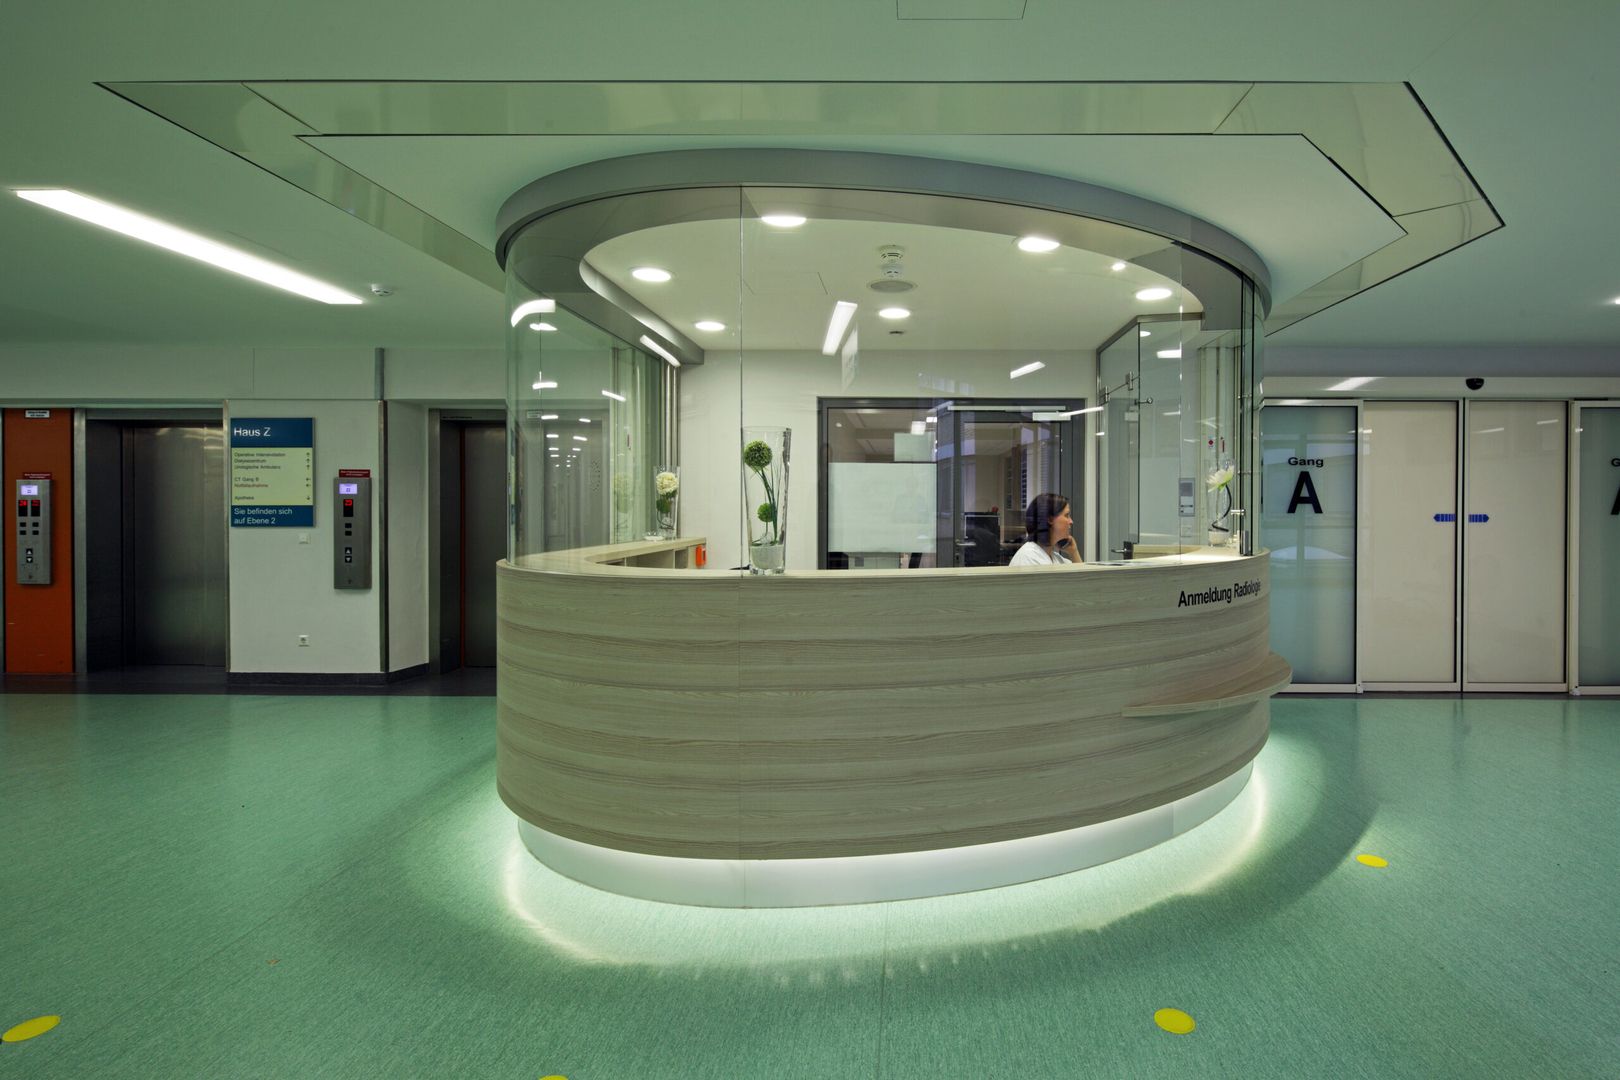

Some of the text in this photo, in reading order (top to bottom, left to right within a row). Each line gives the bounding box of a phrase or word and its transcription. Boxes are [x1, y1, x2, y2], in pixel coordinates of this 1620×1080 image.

[233, 426, 271, 437] Haus Z
[1288, 456, 1324, 468] Gang
[1287, 470, 1324, 514] A
[247, 507, 277, 515] befinden
[278, 507, 293, 515] sich
[233, 517, 276, 525] auf Ebene 2
[1178, 586, 1232, 608] Anmeldung
